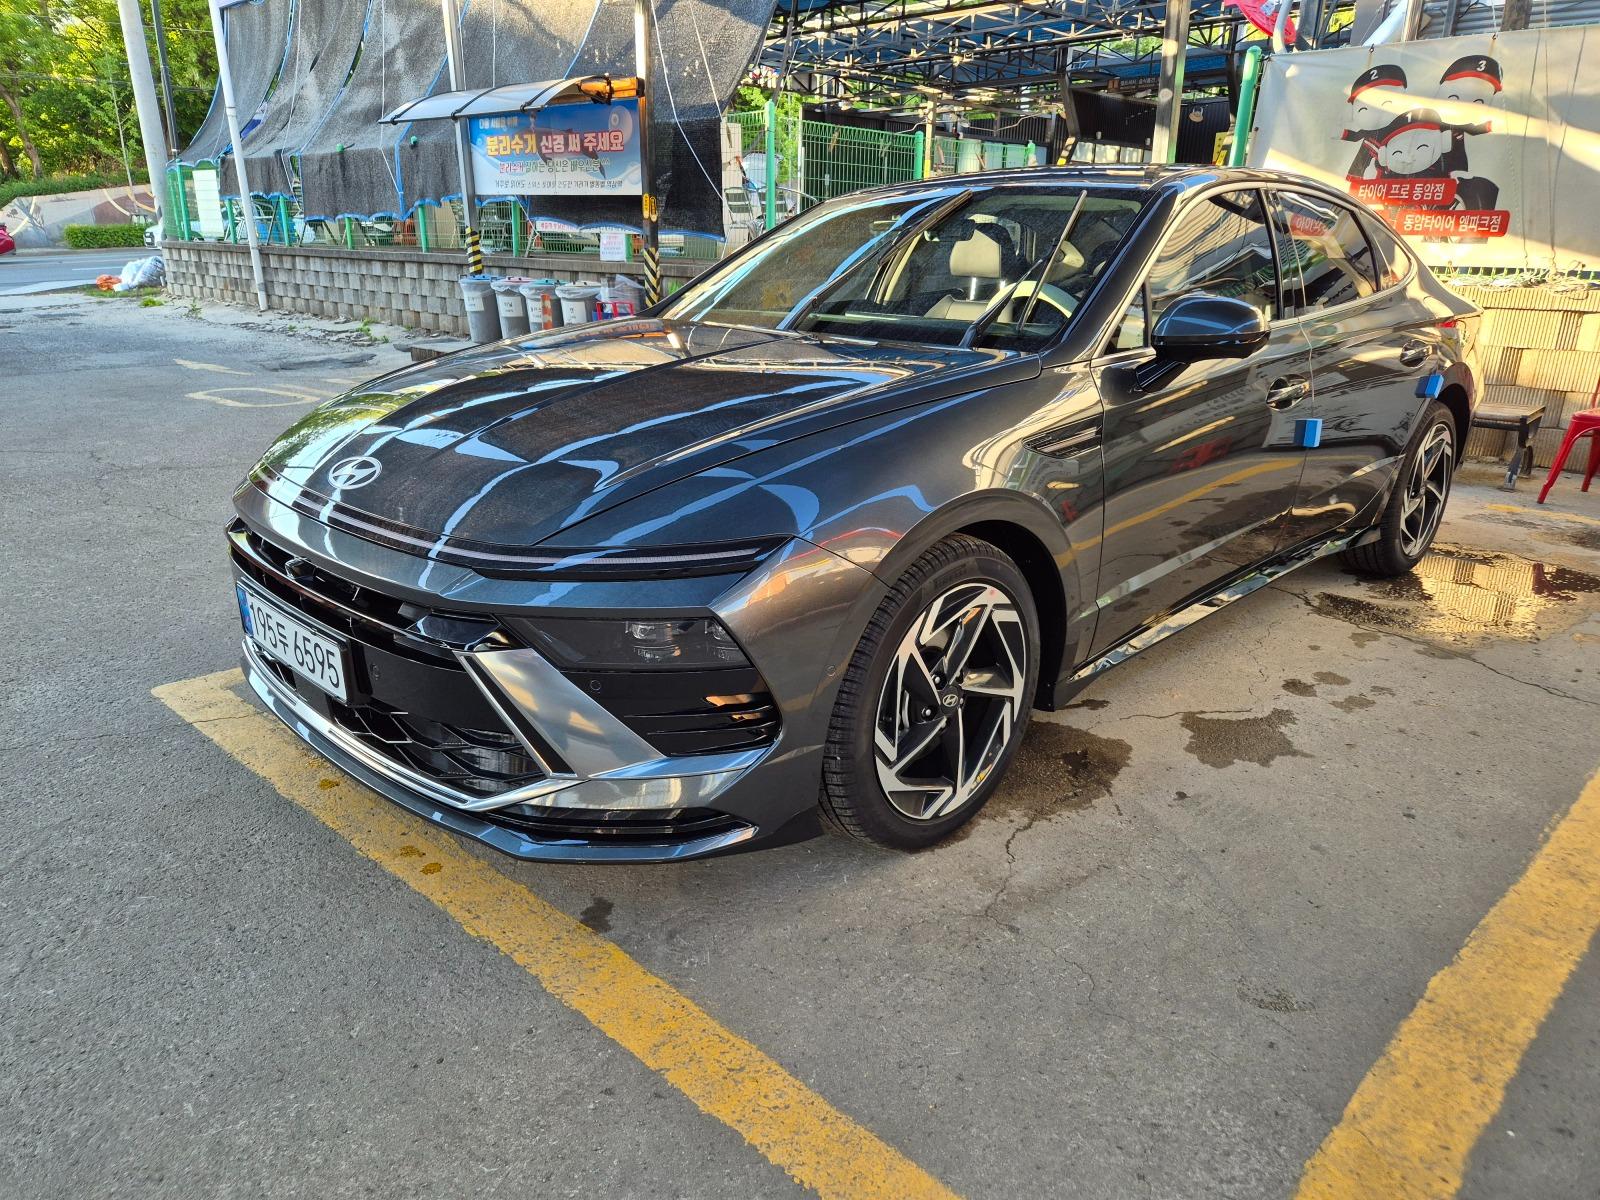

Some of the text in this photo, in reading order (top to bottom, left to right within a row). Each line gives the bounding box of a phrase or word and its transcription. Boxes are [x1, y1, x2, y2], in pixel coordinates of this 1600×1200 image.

[1370, 69, 1379, 80] 2
[1477, 60, 1486, 72] 3
[1406, 112, 1413, 122] 1
[486, 130, 625, 156] 분리수거 신경 써 주세요
[1358, 183, 1445, 200] 타이어 프로 동암점
[1403, 215, 1455, 232] 동암타이어
[1459, 214, 1501, 233] 엠파크점
[249, 601, 340, 689] 195두 6595
